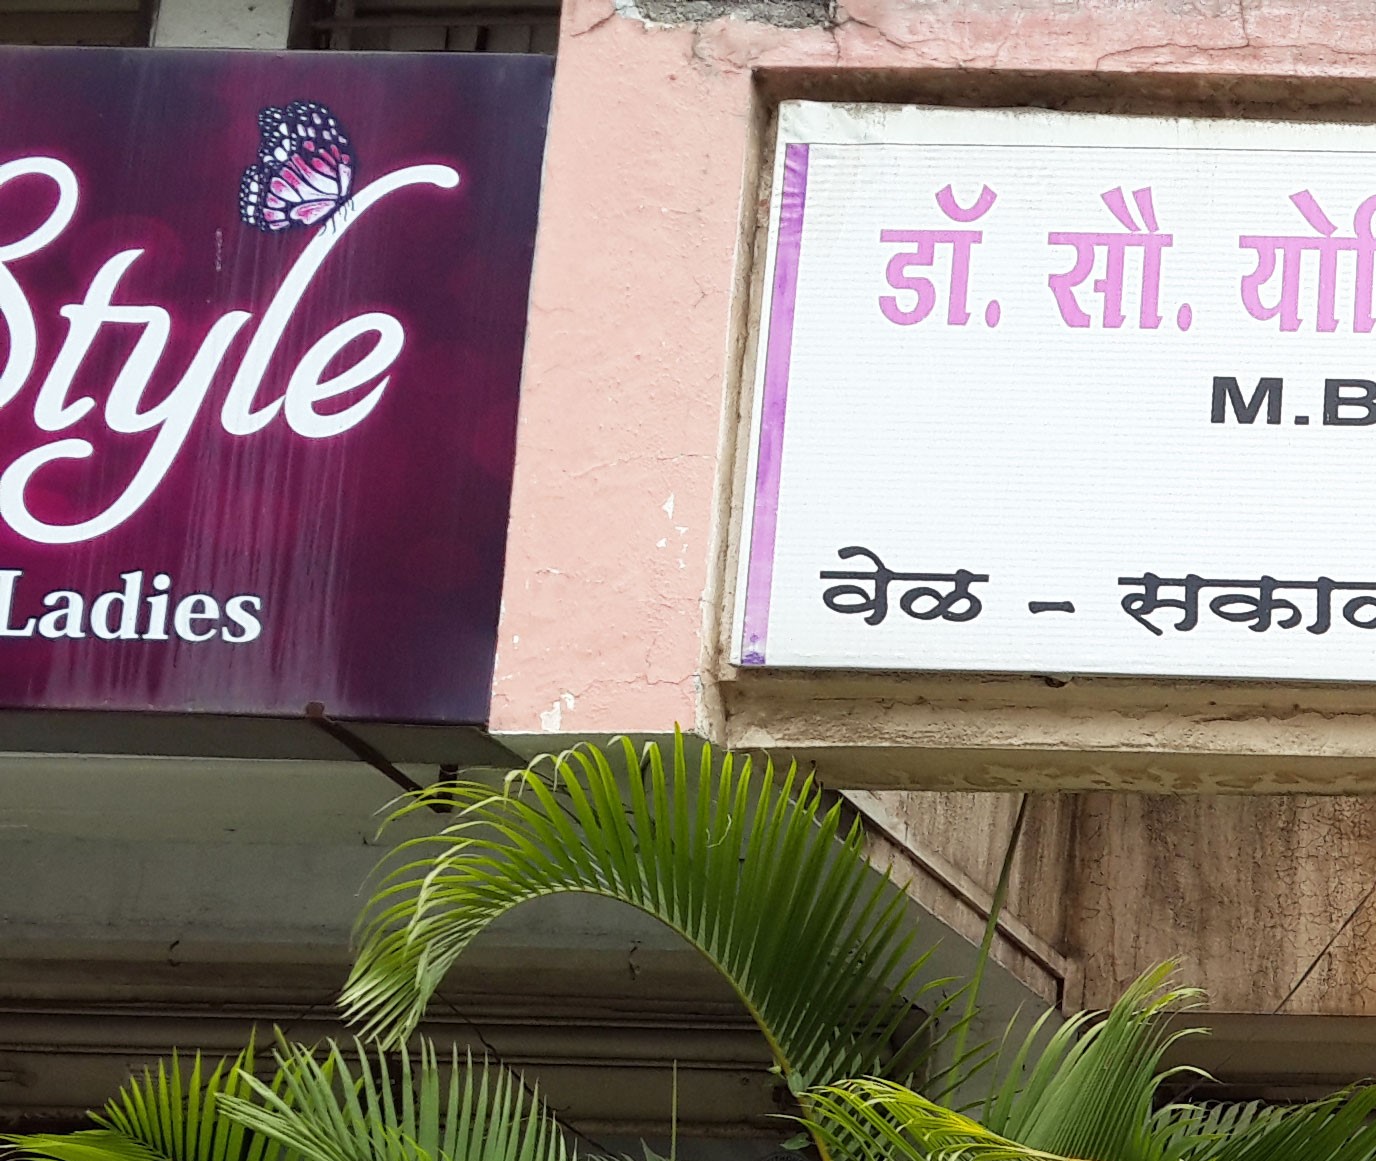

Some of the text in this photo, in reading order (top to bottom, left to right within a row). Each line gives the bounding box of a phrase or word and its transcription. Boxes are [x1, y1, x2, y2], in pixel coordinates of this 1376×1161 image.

[879, 185, 1001, 328] डॉ.
[1047, 187, 1193, 332] सौ.
[819, 545, 990, 626] वेळ
